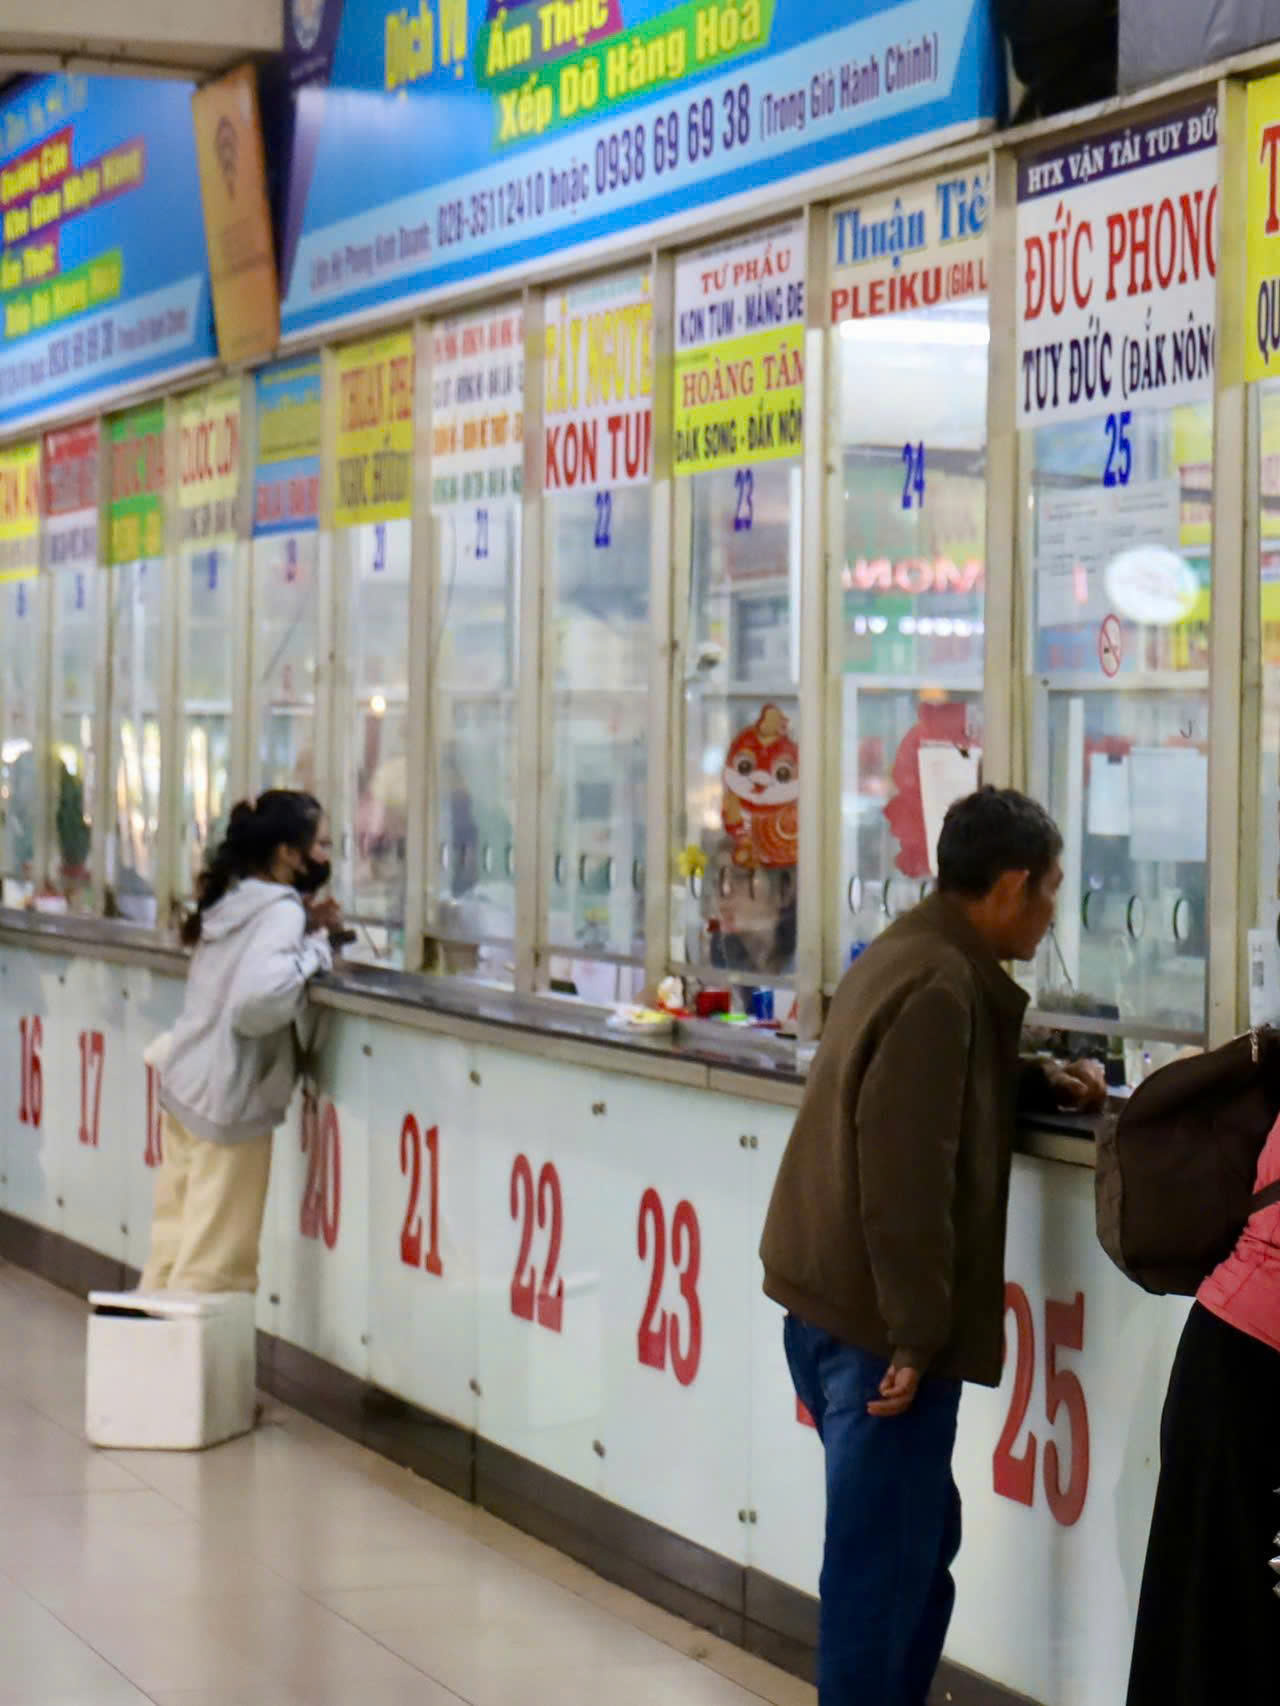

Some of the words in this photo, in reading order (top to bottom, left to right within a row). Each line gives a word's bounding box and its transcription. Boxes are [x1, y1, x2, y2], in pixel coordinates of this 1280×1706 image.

[606, 29, 686, 99] Hàng
[595, 124, 645, 195] 0938
[654, 111, 679, 174] 69
[687, 97, 714, 163] 69
[723, 83, 750, 150] 38
[1028, 157, 1065, 193] HTX
[1146, 122, 1183, 157] TUY
[1187, 107, 1217, 145] ĐỨ
[833, 197, 926, 269] Thuận
[936, 172, 990, 243] Tiế
[1024, 200, 1094, 321] ĐỨC
[831, 266, 942, 323] PLEIKU
[1023, 339, 1063, 412] TUY
[1069, 314, 1113, 406] ĐỨC
[1173, 311, 1215, 388] NÔN
[545, 419, 598, 489] KON
[734, 469, 754, 531] 23
[902, 441, 925, 509] 24
[1103, 410, 1132, 487] 25
[19, 1014, 43, 1129] 16
[79, 1030, 105, 1147] 17
[144, 1062, 162, 1168] 1
[400, 1112, 443, 1276] 21
[510, 1153, 564, 1334] 22
[638, 1187, 701, 1387] 23
[993, 1281, 1090, 1526] 25
